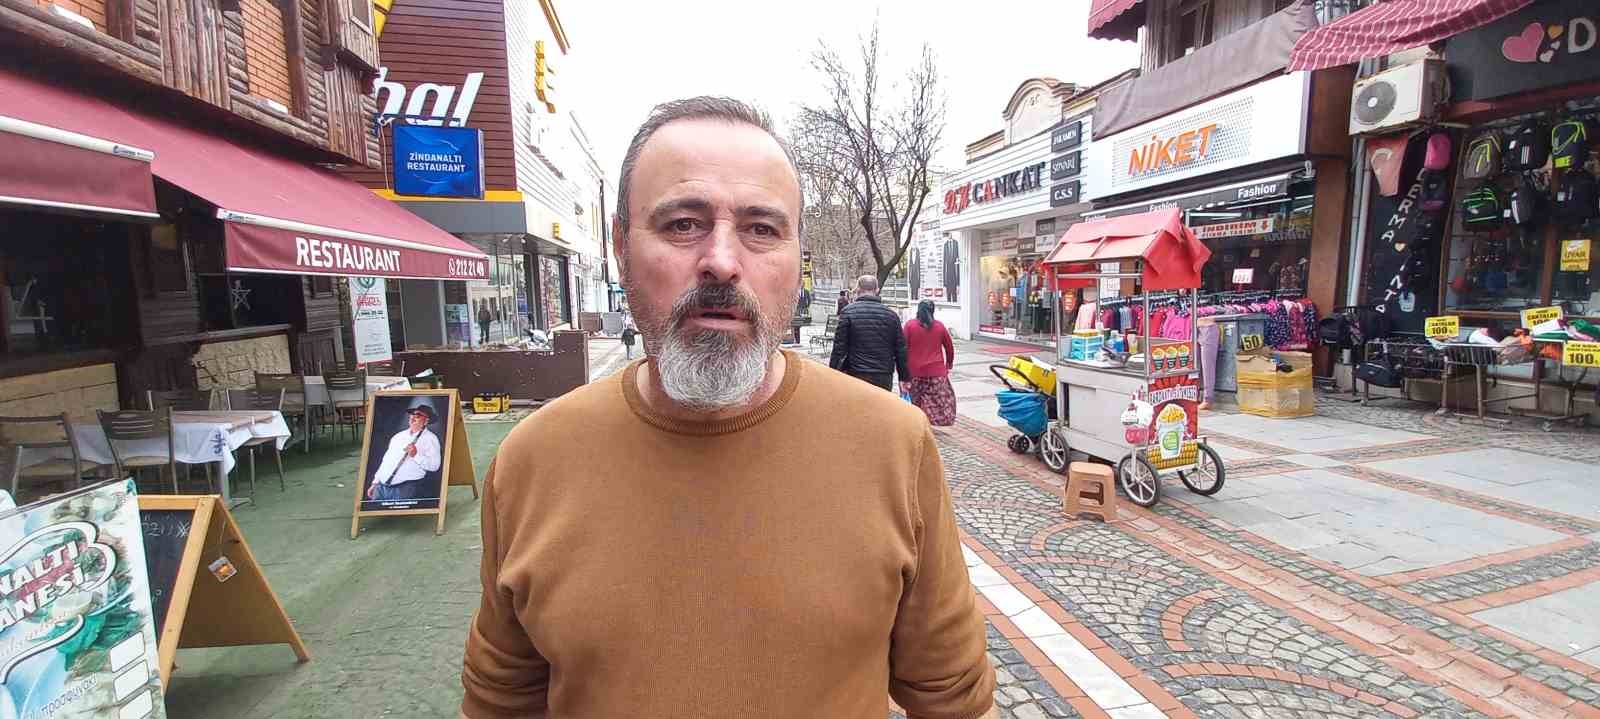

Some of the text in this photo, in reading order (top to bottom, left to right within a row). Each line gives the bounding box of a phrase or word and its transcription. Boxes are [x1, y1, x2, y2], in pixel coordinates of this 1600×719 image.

[1127, 123, 1217, 176] NİKET
[409, 151, 463, 163] ZİNDANALTI
[407, 162, 466, 172] RESTAURANT
[973, 161, 1046, 204] CANKAT
[1237, 182, 1277, 199] Fashion
[295, 236, 401, 272] RESTAURANT
[456, 261, 468, 275] 212
[1431, 326, 1448, 335] 100
[1243, 335, 1261, 349] 50
[1568, 352, 1594, 364] 100
